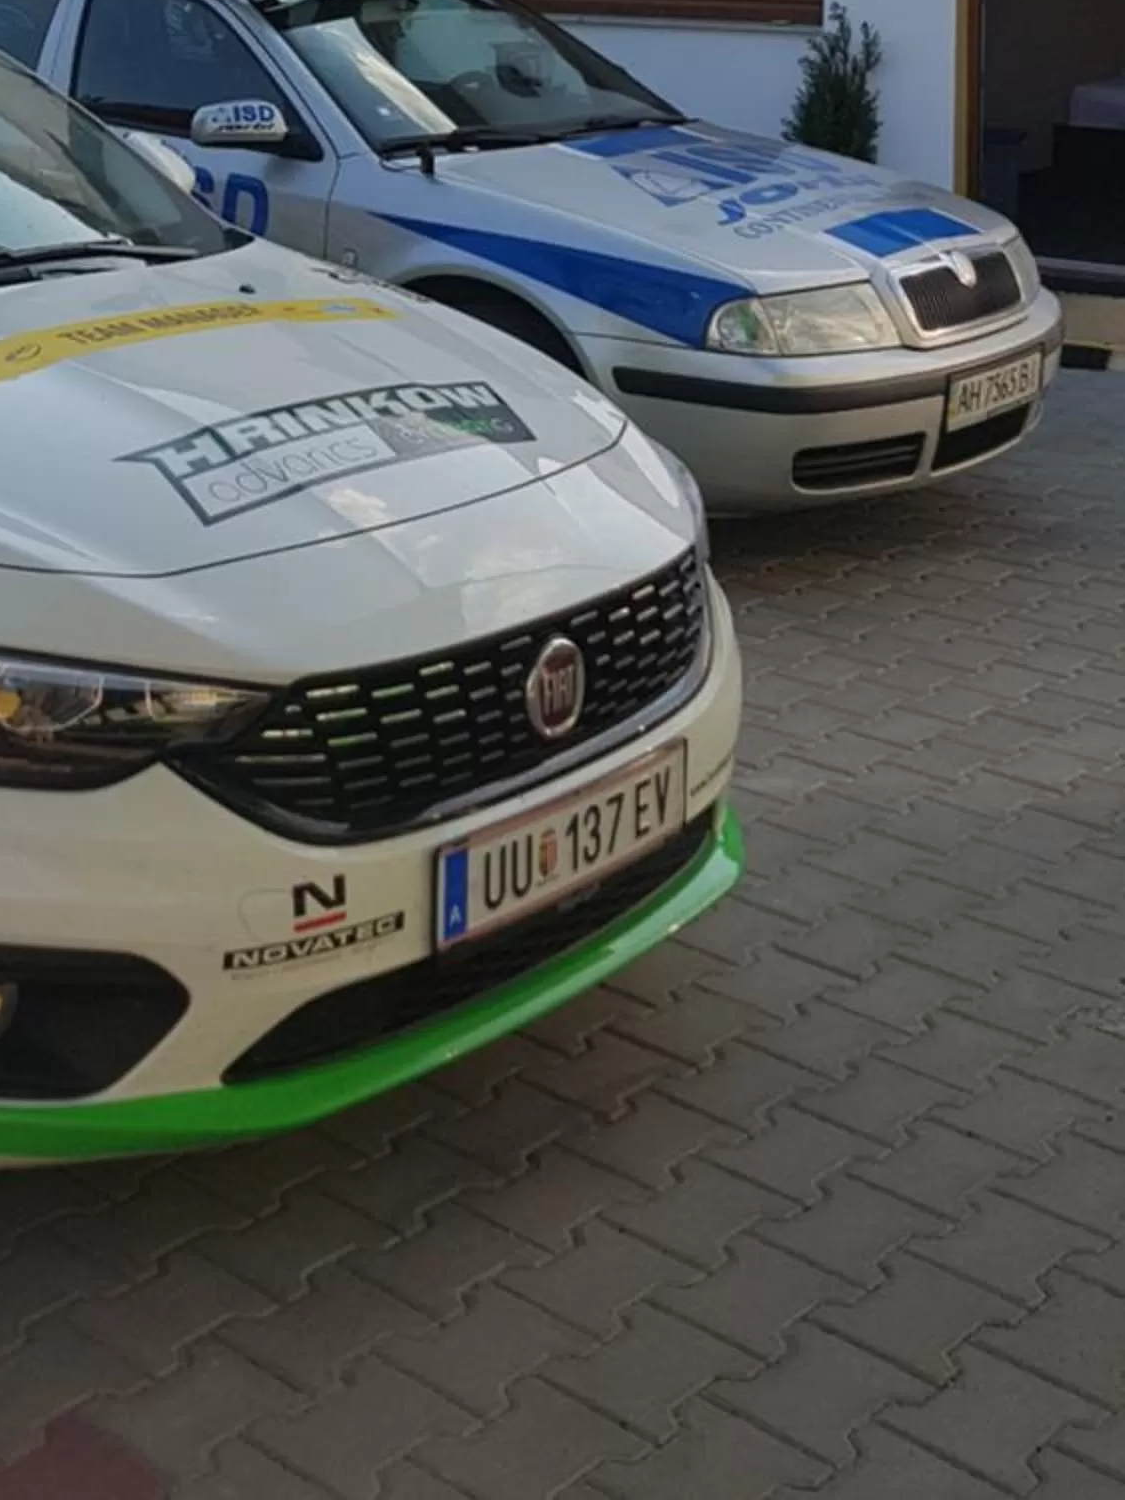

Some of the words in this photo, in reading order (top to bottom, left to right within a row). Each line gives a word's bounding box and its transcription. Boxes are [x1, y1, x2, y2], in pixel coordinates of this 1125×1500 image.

[233, 104, 275, 123] ISD
[59, 319, 137, 346] TEAM
[138, 302, 263, 333] MANAGER
[144, 384, 500, 479] HRINKOW
[209, 436, 380, 503] advarics
[449, 904, 463, 924] A
[484, 833, 534, 910] UU
[565, 791, 626, 872] 137
[633, 765, 671, 839] EV
[231, 913, 404, 969] NOVATEC
